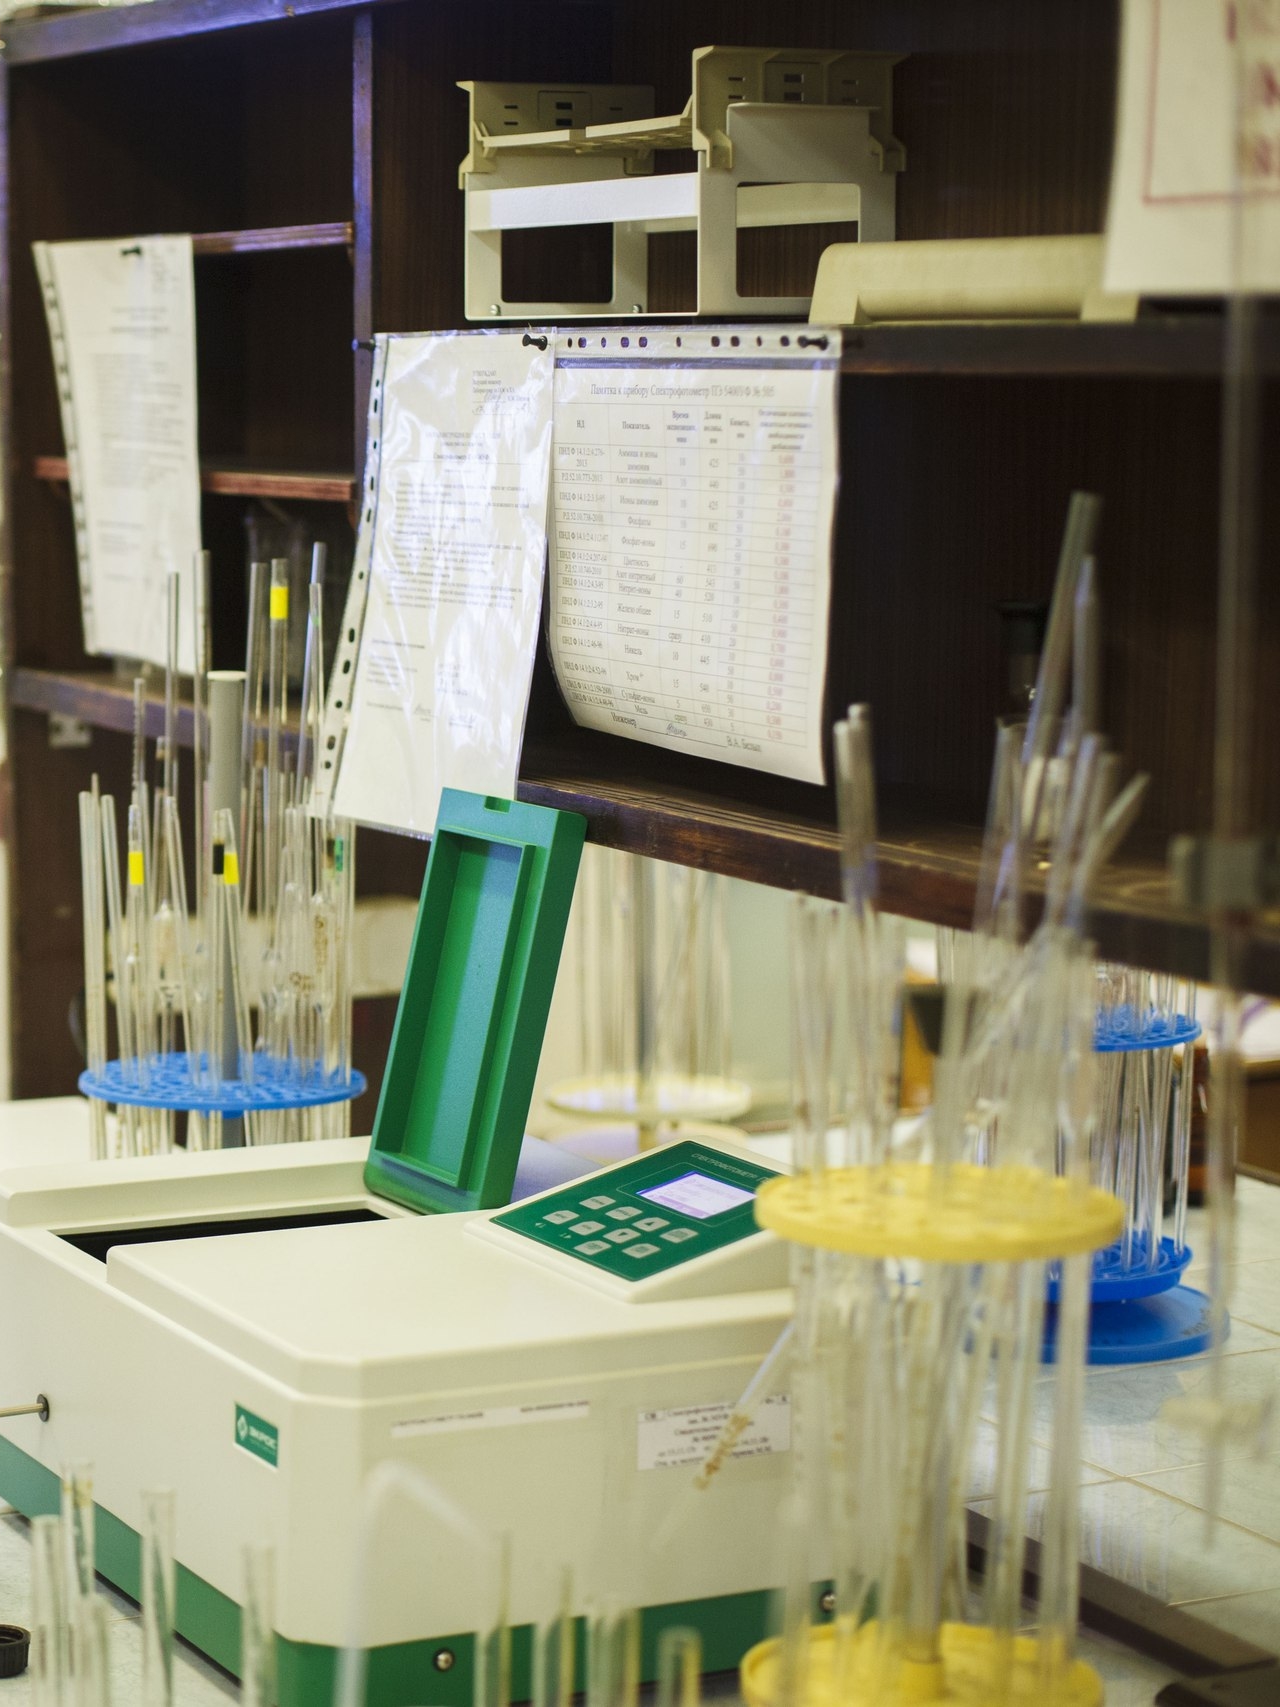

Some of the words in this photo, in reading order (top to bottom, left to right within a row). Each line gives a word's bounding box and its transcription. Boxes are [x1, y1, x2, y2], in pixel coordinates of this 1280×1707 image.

[591, 384, 617, 396] Памятка
[623, 384, 649, 398] прибору
[650, 385, 709, 399] Спектрофотометр
[622, 421, 651, 431] Показатель
